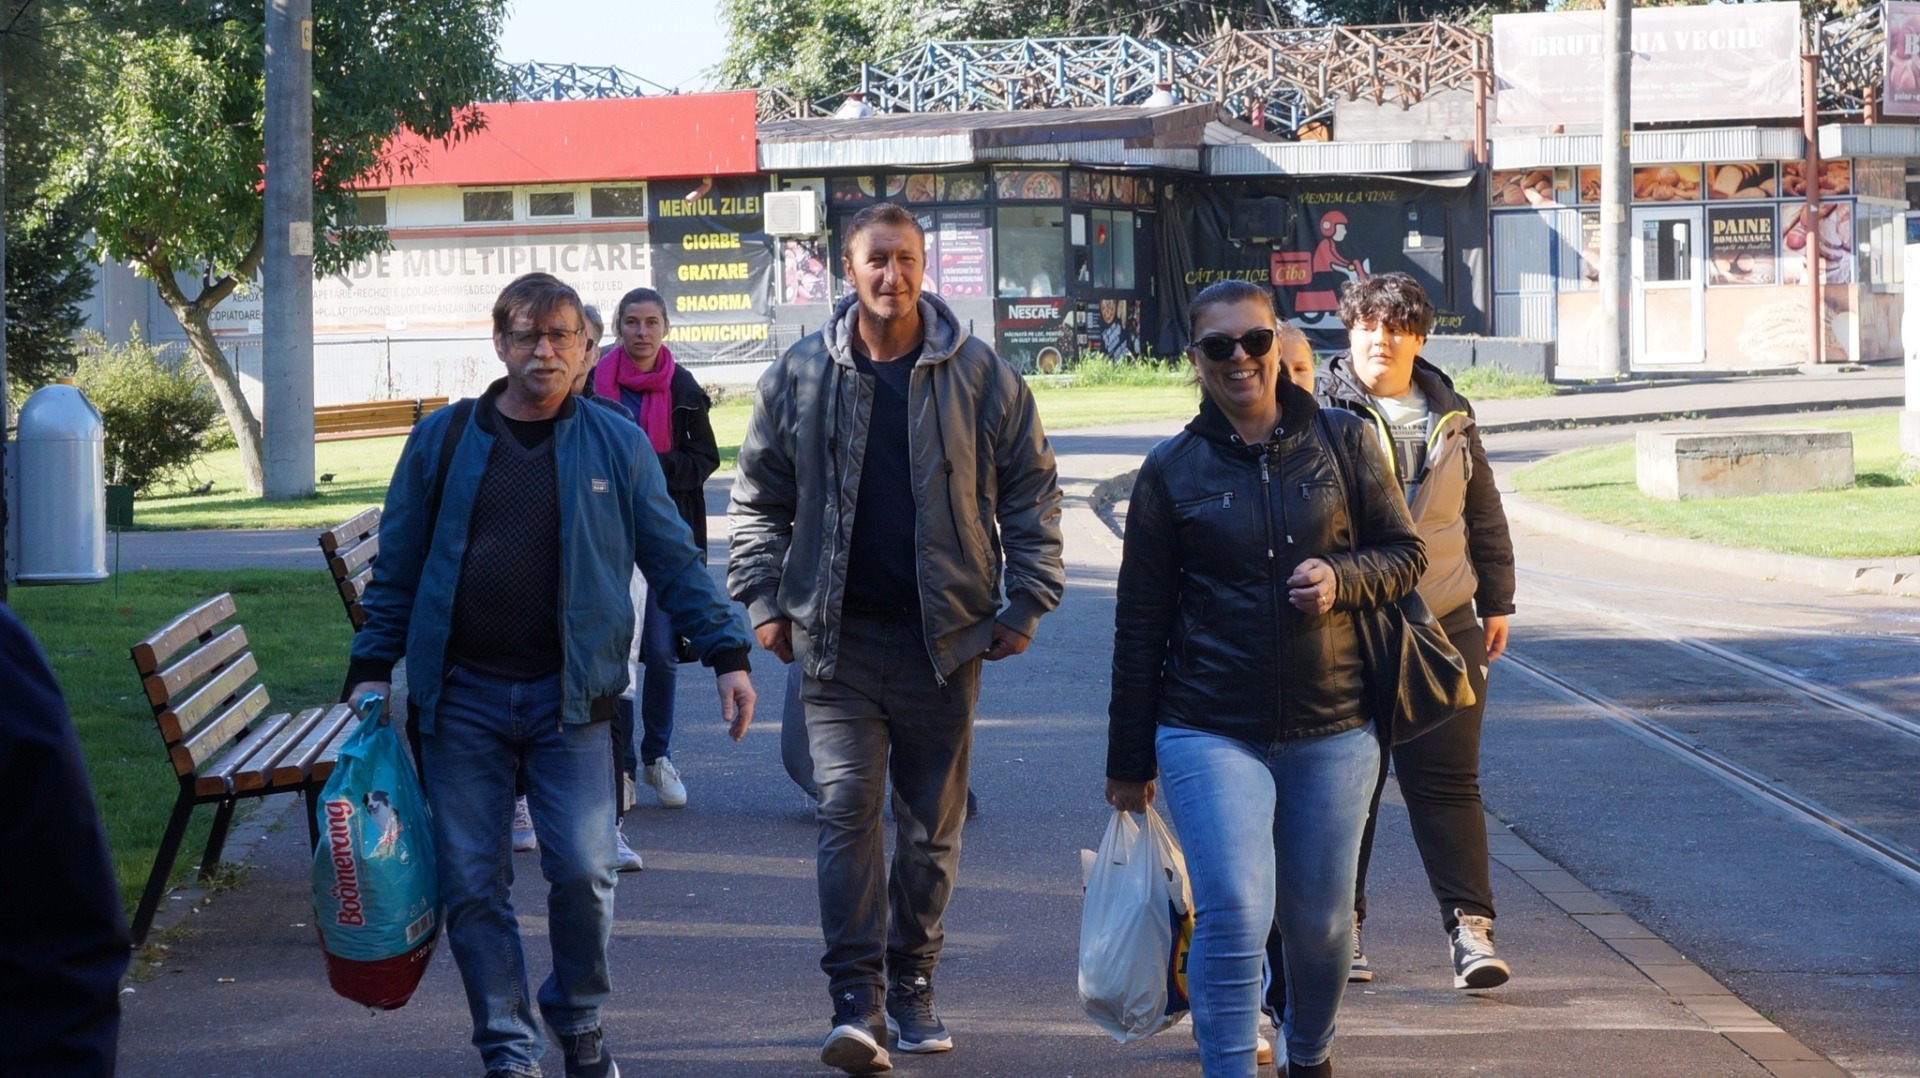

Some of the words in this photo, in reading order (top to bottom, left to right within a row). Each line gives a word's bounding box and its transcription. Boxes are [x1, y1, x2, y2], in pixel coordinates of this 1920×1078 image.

[1530, 31, 1669, 57] BRUTIA
[1673, 27, 1764, 52] VECHE
[659, 198, 717, 218] MENIUL
[720, 196, 759, 216] ZILEI
[1298, 191, 1343, 205] VENIM
[1346, 191, 1363, 204] LA
[1365, 190, 1397, 203] TINE
[1712, 217, 1771, 235] PAINE
[682, 232, 741, 250] CIORBE
[1712, 234, 1771, 244] ROMANEASCA
[353, 251, 390, 279] DE
[403, 242, 646, 278] MULTIPLICARE
[677, 262, 749, 281] GRATARE
[1275, 264, 1307, 283] Cibo
[232, 291, 260, 303] XEROX
[592, 279, 605, 292] CU
[606, 279, 624, 291] LED
[676, 293, 752, 312] SHAORMA
[209, 309, 260, 321] COPIATOARE
